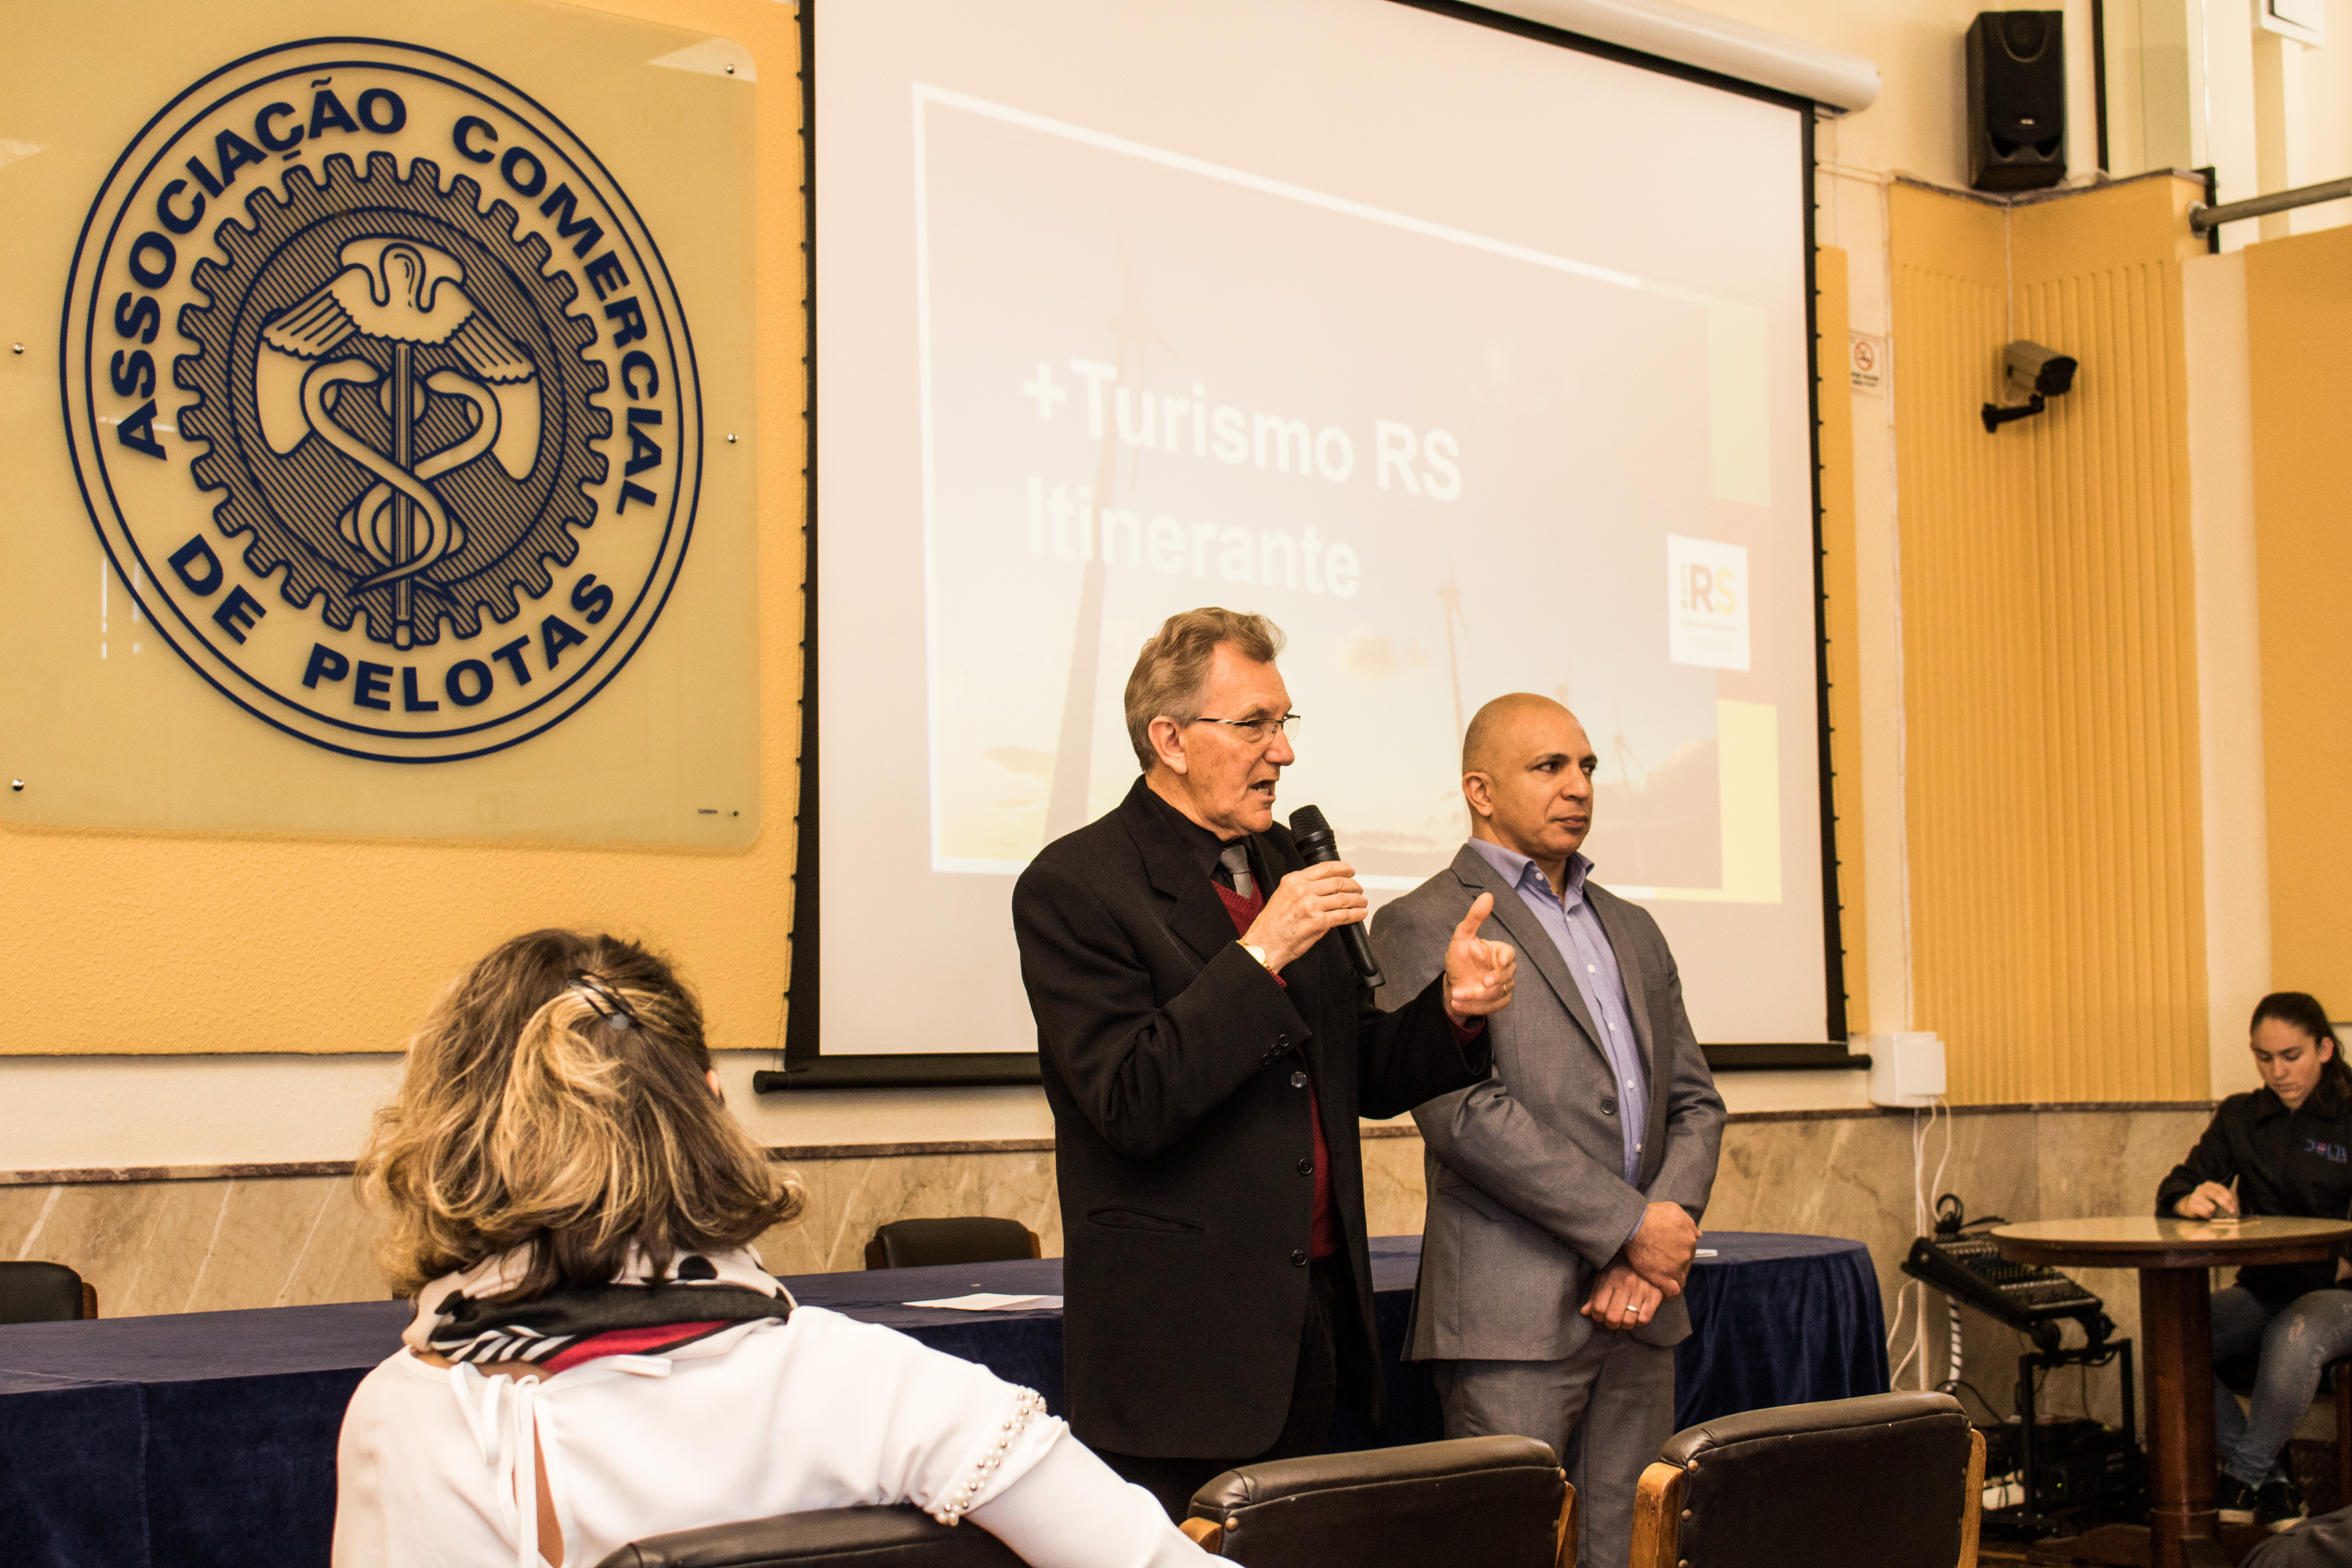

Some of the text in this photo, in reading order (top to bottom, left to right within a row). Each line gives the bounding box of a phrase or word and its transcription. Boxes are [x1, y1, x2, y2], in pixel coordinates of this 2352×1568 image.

[109, 76, 663, 516] ASSOCIAÇÃO COMERCIAL
[1375, 419, 1462, 502] RS
[1026, 475, 1359, 598] Itinerante
[1689, 563, 1737, 616] RS
[166, 533, 615, 714] DE PELOTAS
